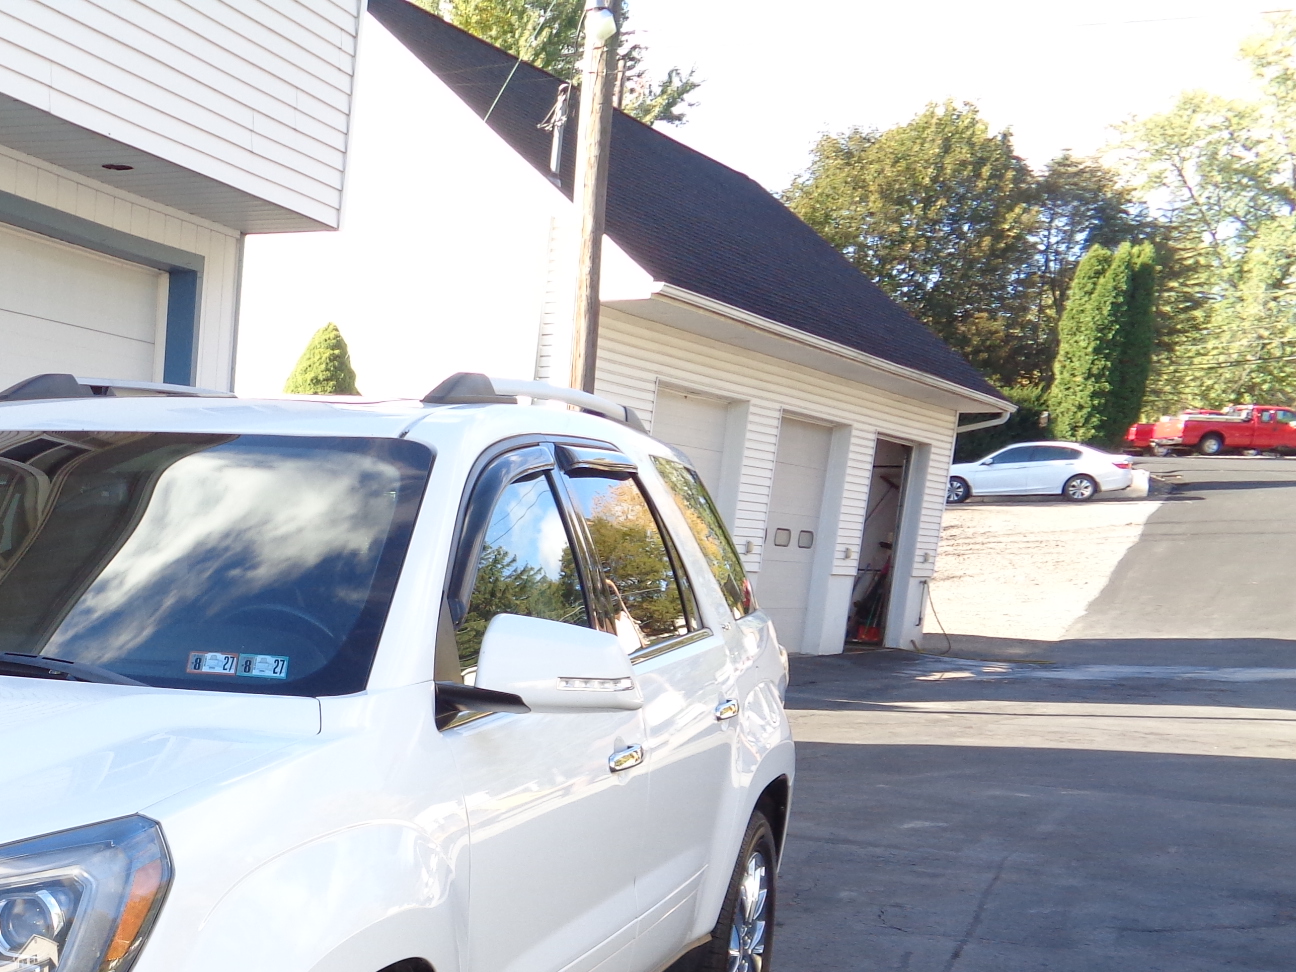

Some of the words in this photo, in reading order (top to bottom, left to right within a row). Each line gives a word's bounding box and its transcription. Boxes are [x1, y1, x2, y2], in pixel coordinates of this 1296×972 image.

[193, 657, 203, 671] 8
[222, 656, 235, 672] 27
[243, 659, 252, 673] 8
[272, 659, 286, 675] 27
